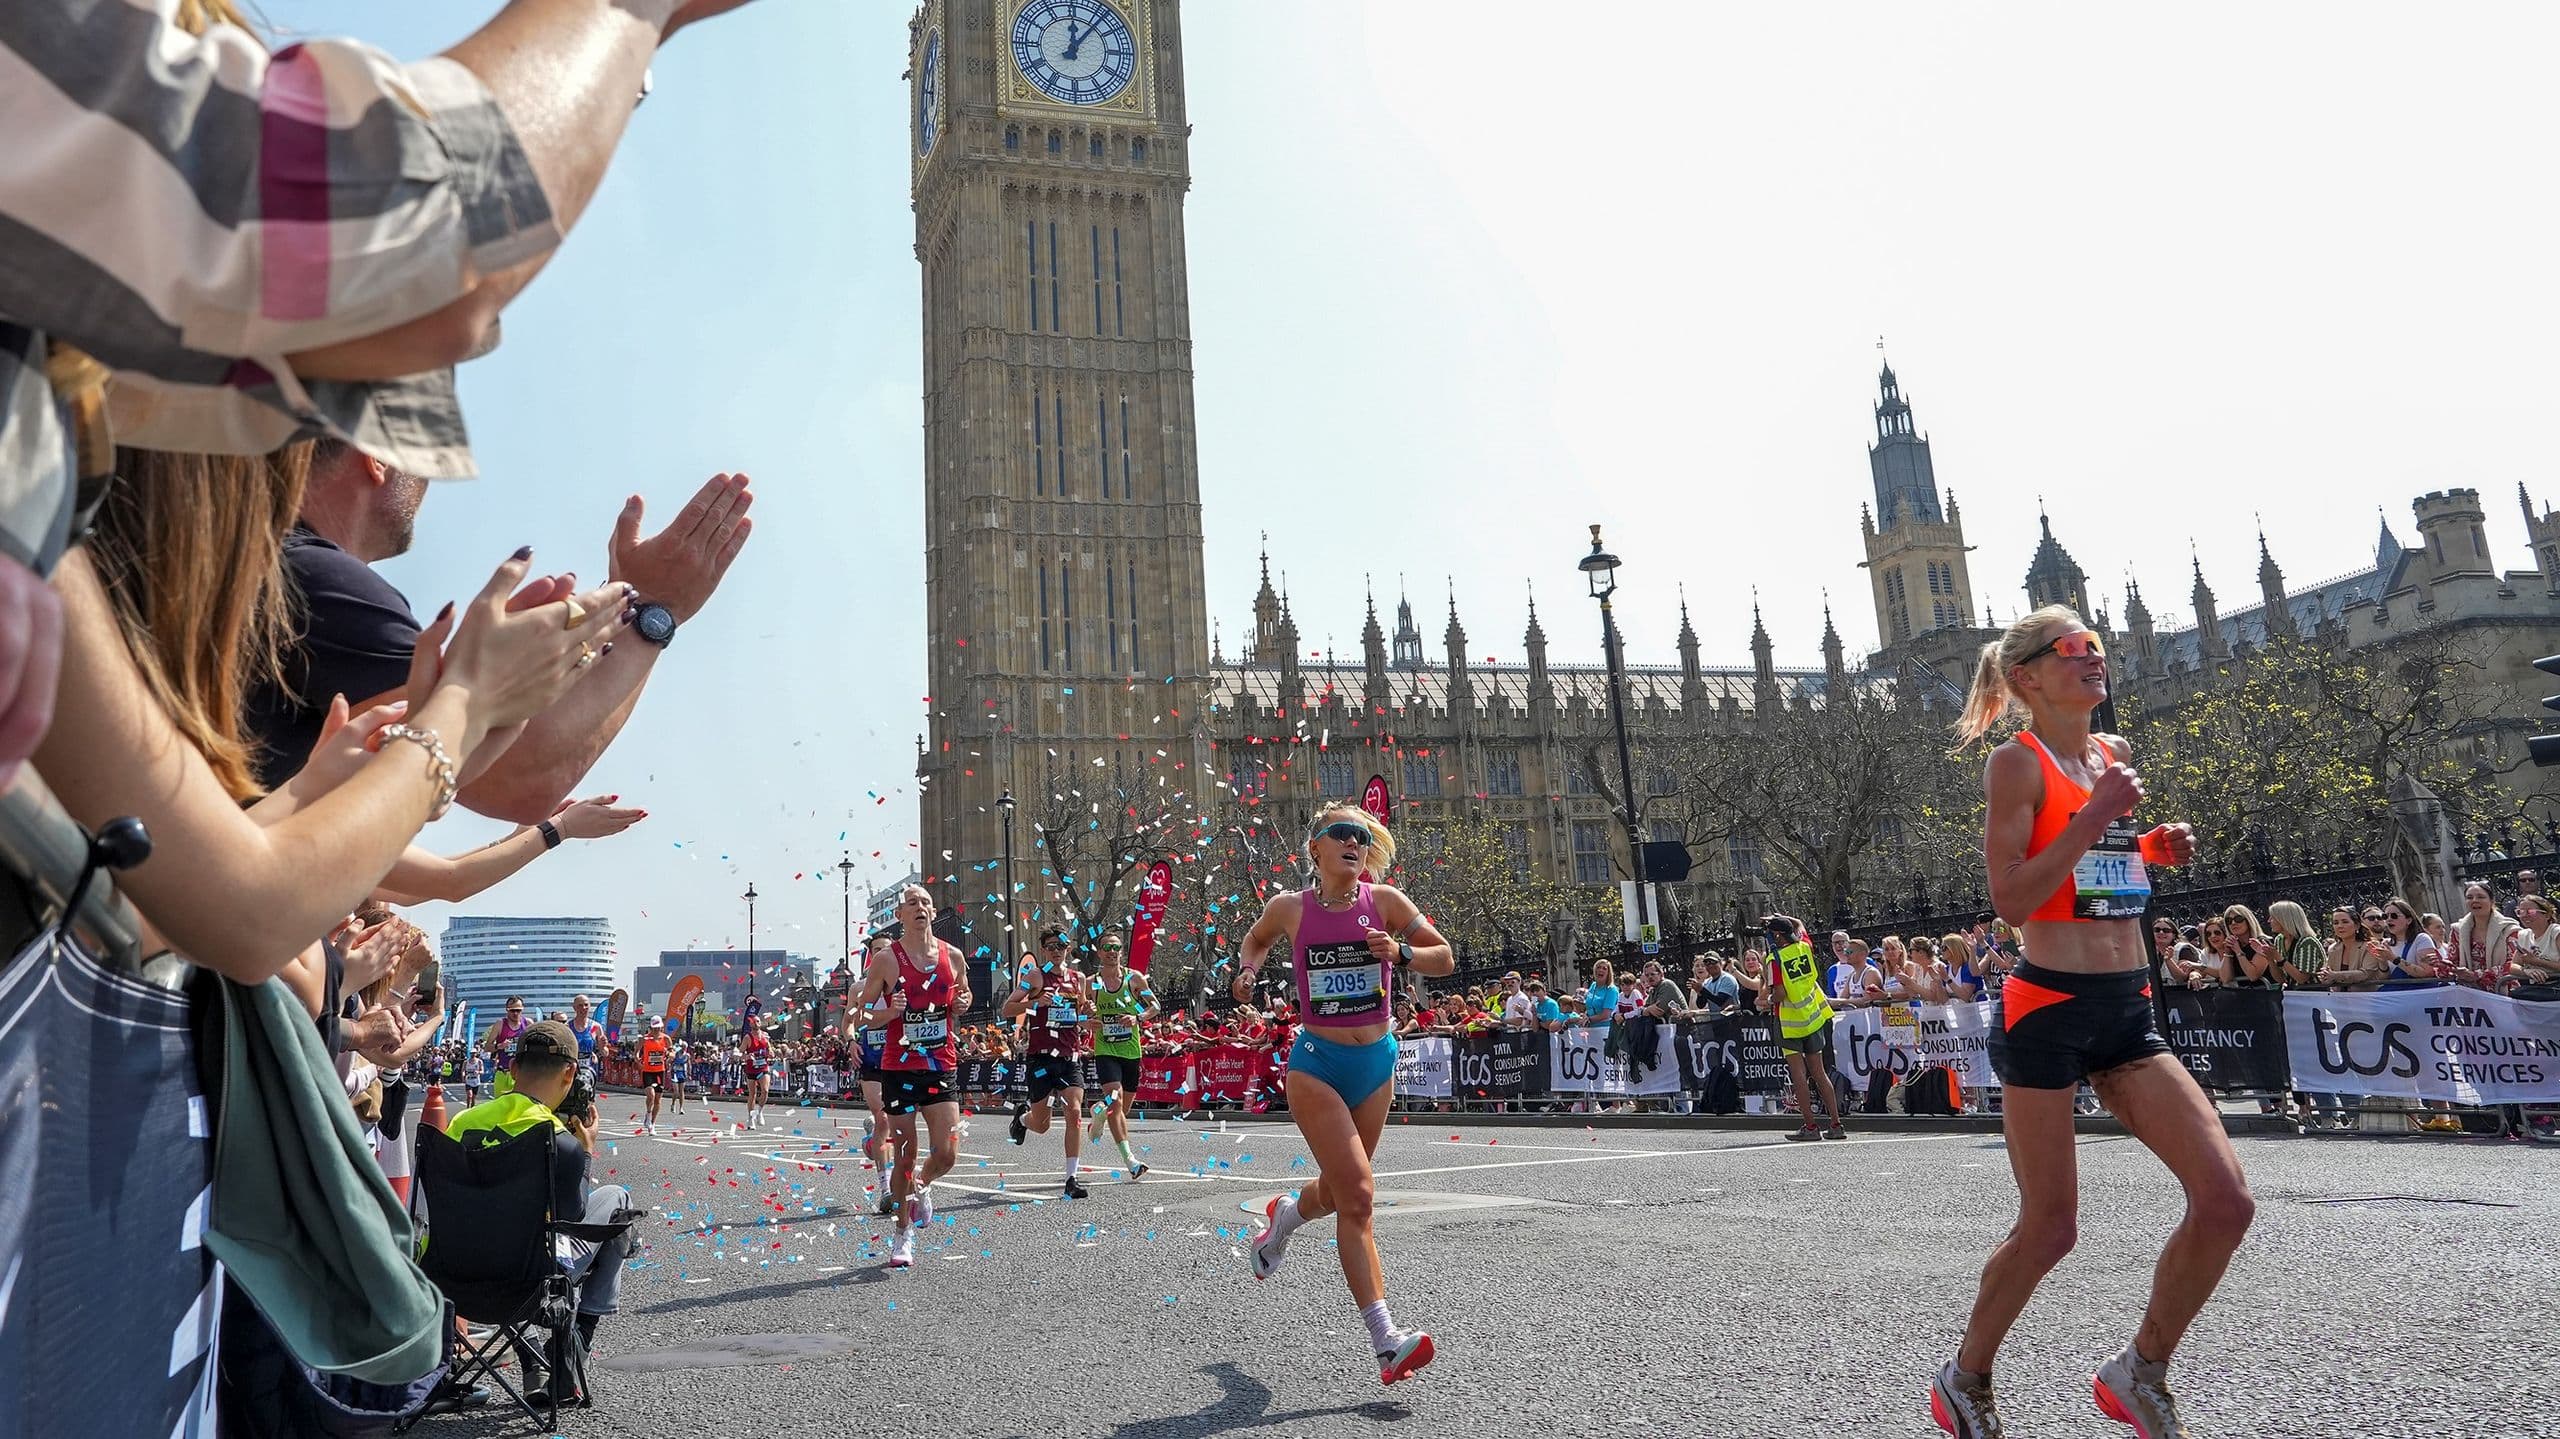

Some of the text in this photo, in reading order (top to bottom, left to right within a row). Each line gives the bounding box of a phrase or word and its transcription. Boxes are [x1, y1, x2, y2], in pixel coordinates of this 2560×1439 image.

[2095, 859, 2128, 885] 2117
[1308, 949, 1336, 966] tcs
[1324, 973, 1366, 994] 2095
[1354, 1003, 1377, 1012] balance
[905, 1010, 923, 1022] tcs
[1889, 1015, 1915, 1025] GOING
[2425, 1007, 2495, 1028] TATA
[914, 1025, 940, 1038] 1228
[1741, 1028, 1771, 1041] TATA
[1921, 1019, 1949, 1035] ATA
[1493, 1043, 1512, 1056] TATA
[1850, 1025, 1908, 1076] tcs
[2312, 1008, 2420, 1078] tcs
[1399, 1049, 1417, 1059] TATA
[1493, 1053, 1540, 1071] CONSULTANCY
[1560, 1038, 1600, 1081] tcs
[1687, 1035, 1740, 1079] tcs
[1394, 1061, 1442, 1073] CONSULTANCY
[1459, 1047, 1492, 1086] tcs
[1744, 1063, 1790, 1079] SERVICES
[2436, 1062, 2545, 1083] SERVICES
[1215, 1073, 1243, 1083] Foundation
[1396, 1075, 1428, 1087] SERVICES
[1494, 1070, 1522, 1086] SERVICES
